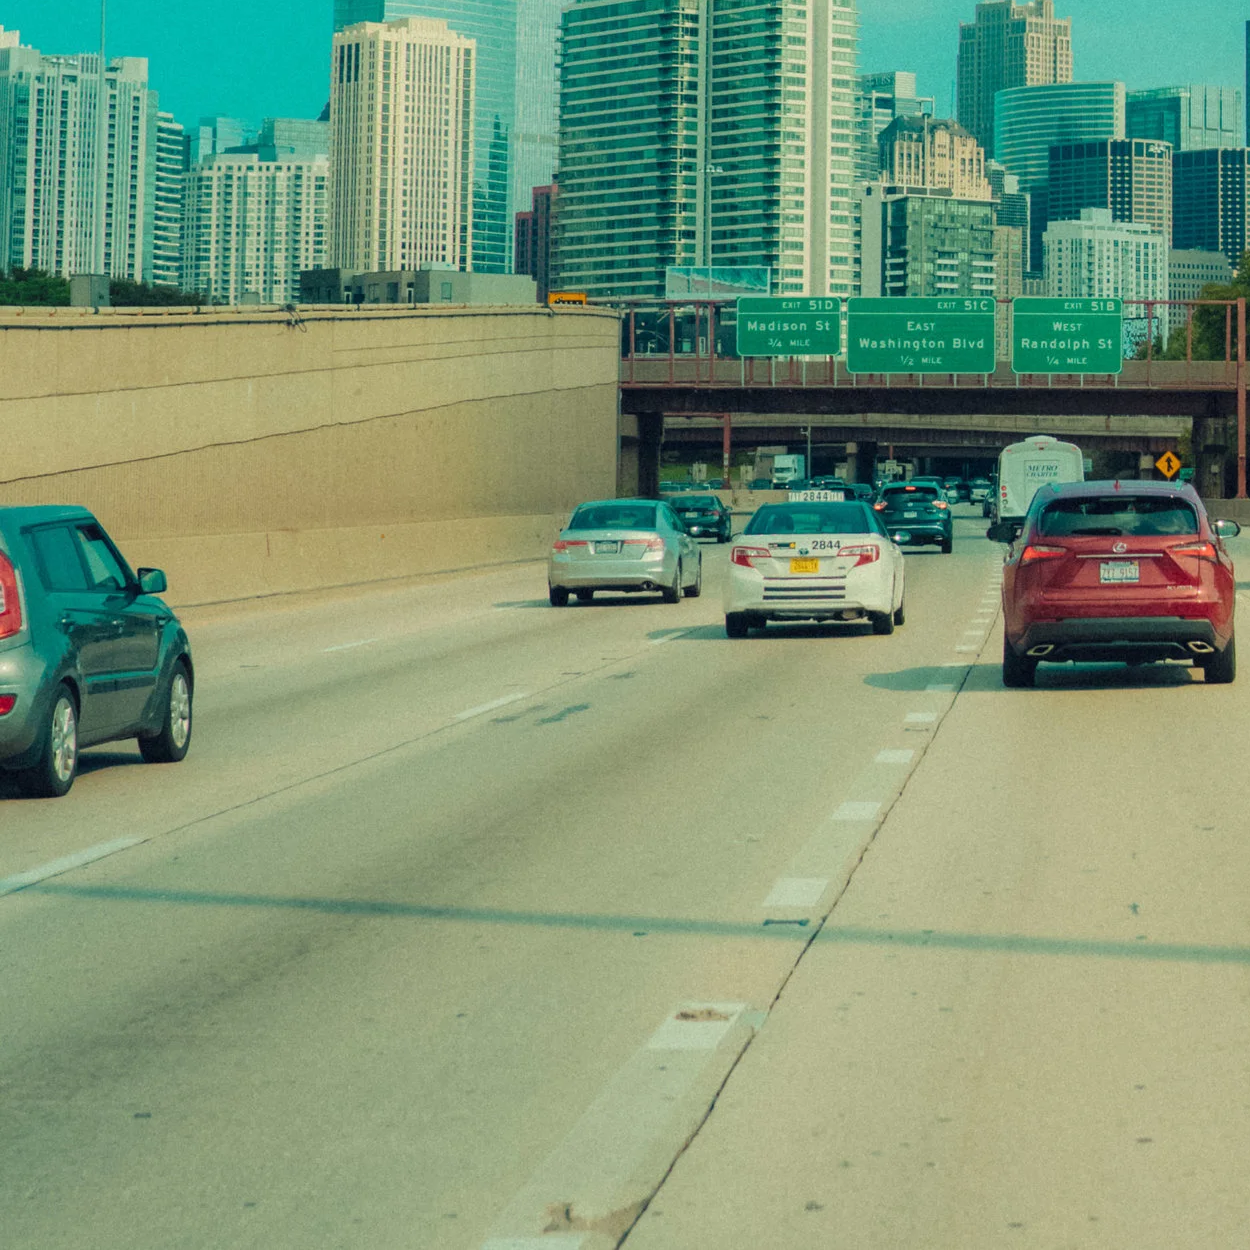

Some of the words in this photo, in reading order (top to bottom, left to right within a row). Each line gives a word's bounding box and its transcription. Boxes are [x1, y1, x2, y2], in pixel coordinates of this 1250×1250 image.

[782, 301, 801, 309] EXIT
[809, 300, 834, 311] 51D
[964, 300, 989, 311] 51C
[1064, 302, 1083, 310] EXIT
[1091, 301, 1115, 311] 51B
[747, 320, 807, 331] Madison
[815, 320, 830, 331] St
[907, 321, 936, 331] EAST
[1053, 321, 1083, 331] WEST
[789, 339, 811, 347] MILE
[859, 337, 945, 352] Washington
[952, 338, 985, 349] Blvd
[1021, 338, 1090, 350] Randolph
[1098, 338, 1113, 349] St
[1067, 357, 1088, 365] MILE
[803, 491, 829, 502] 2844
[812, 540, 841, 550] 2844
